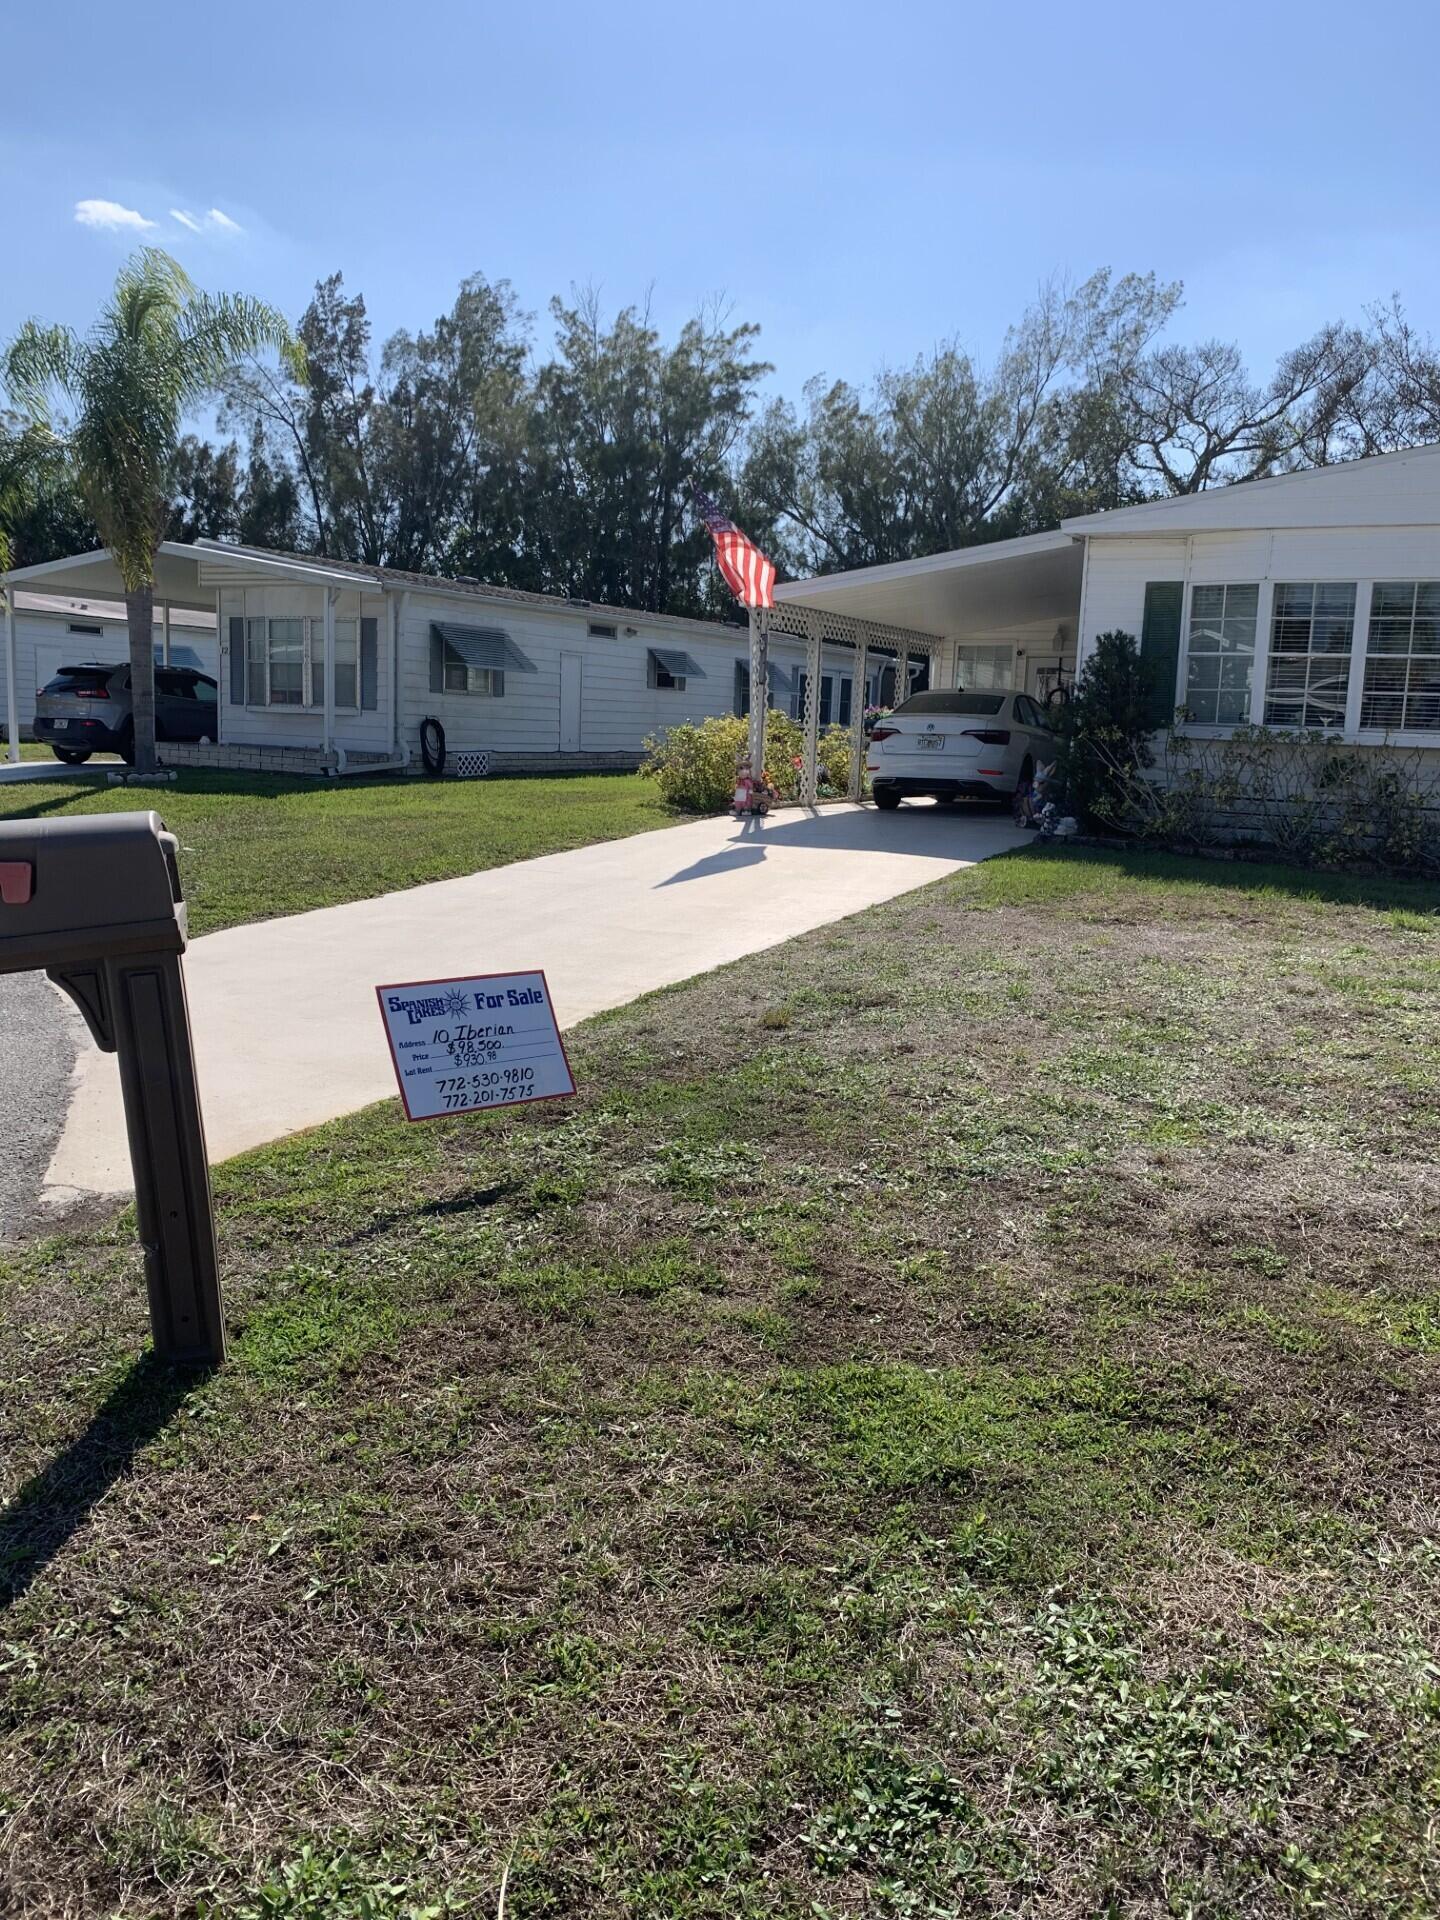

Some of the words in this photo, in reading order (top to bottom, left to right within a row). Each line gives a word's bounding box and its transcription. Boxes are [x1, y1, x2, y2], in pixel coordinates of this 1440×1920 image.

[474, 992, 504, 1010] For
[507, 988, 543, 1007] Sale
[433, 1029, 449, 1044] 10
[453, 1024, 514, 1041] Iberian
[398, 1040, 426, 1049] Address
[412, 1053, 429, 1062] Price
[404, 1068, 416, 1077] Lot
[417, 1066, 433, 1075] Rent
